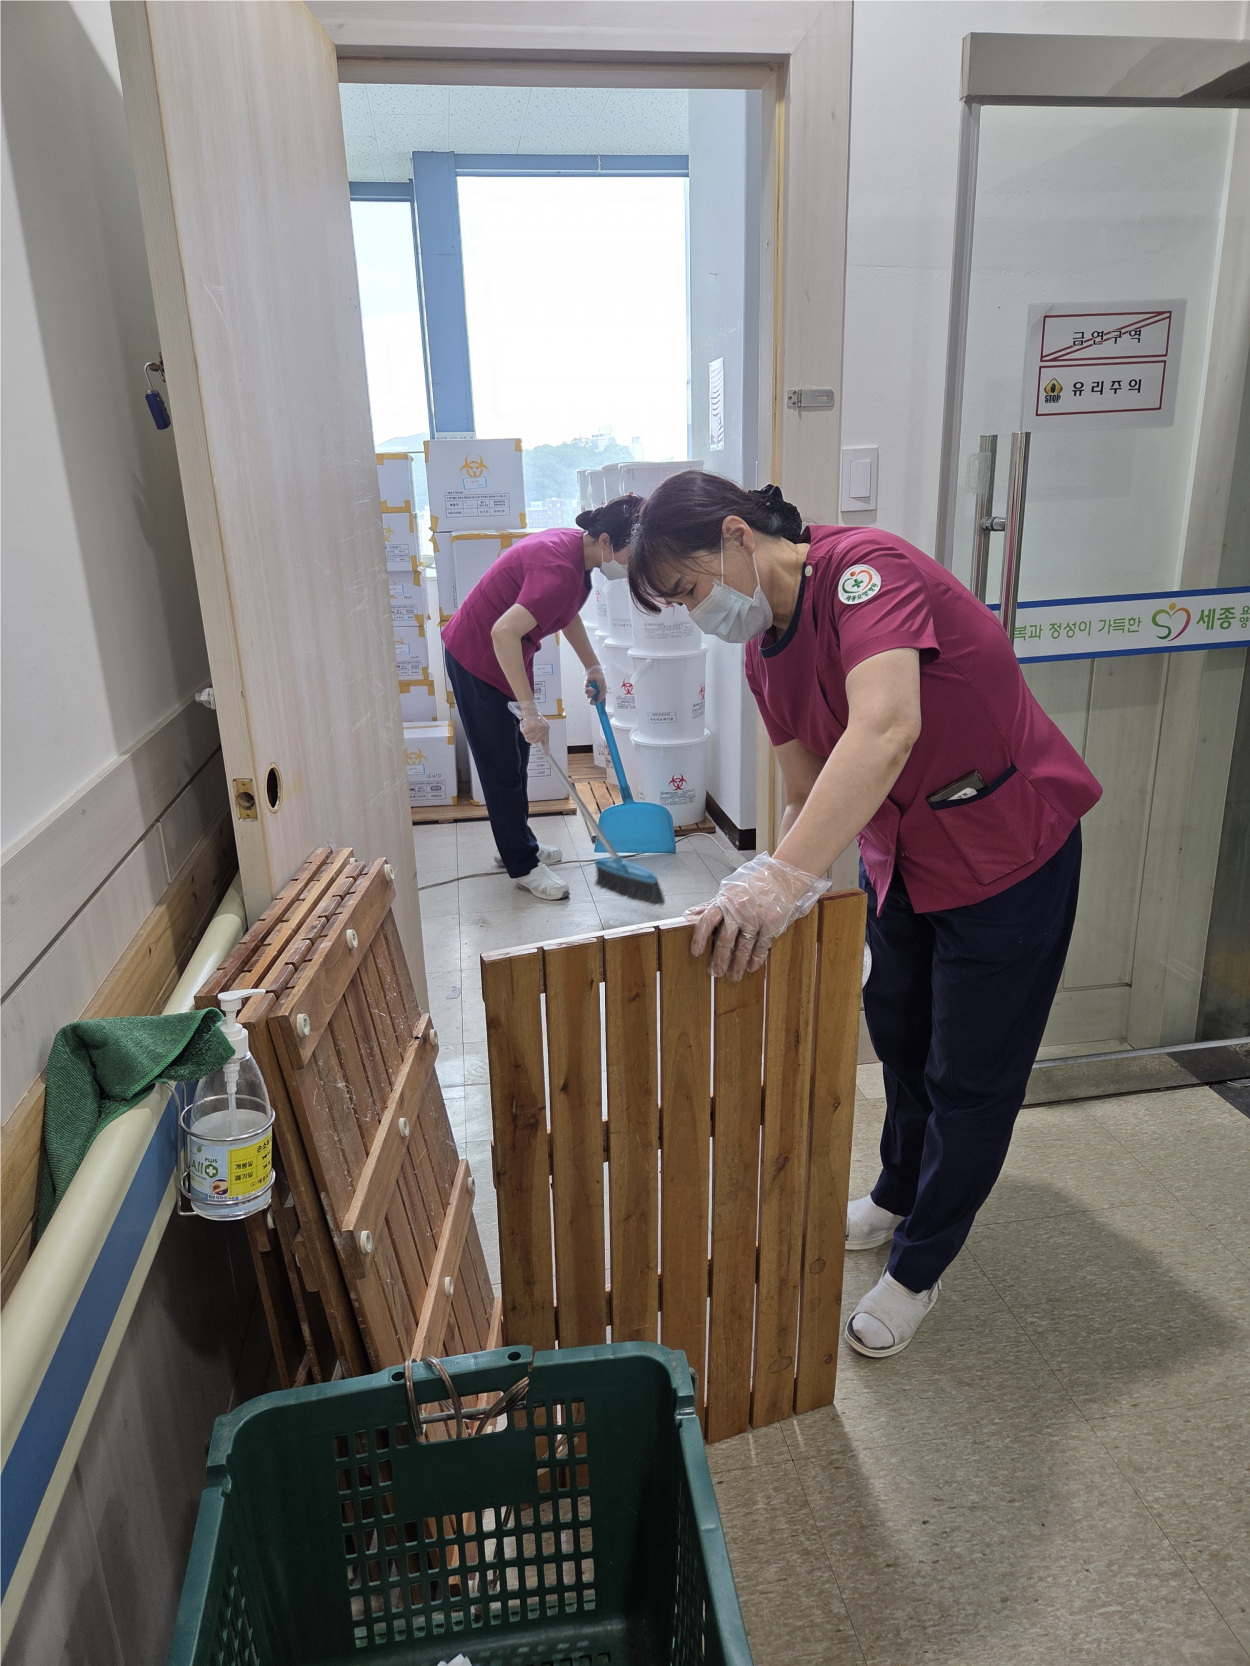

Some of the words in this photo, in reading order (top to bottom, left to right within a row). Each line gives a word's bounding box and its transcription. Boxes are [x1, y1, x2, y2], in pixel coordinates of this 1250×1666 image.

[1072, 329, 1142, 346] 금연구역
[1071, 378, 1142, 397] 유리주의
[1044, 394, 1061, 404] STOP
[1048, 619, 1092, 640] 정성이
[1097, 616, 1142, 634] 가득한
[1196, 606, 1237, 631] 세종
